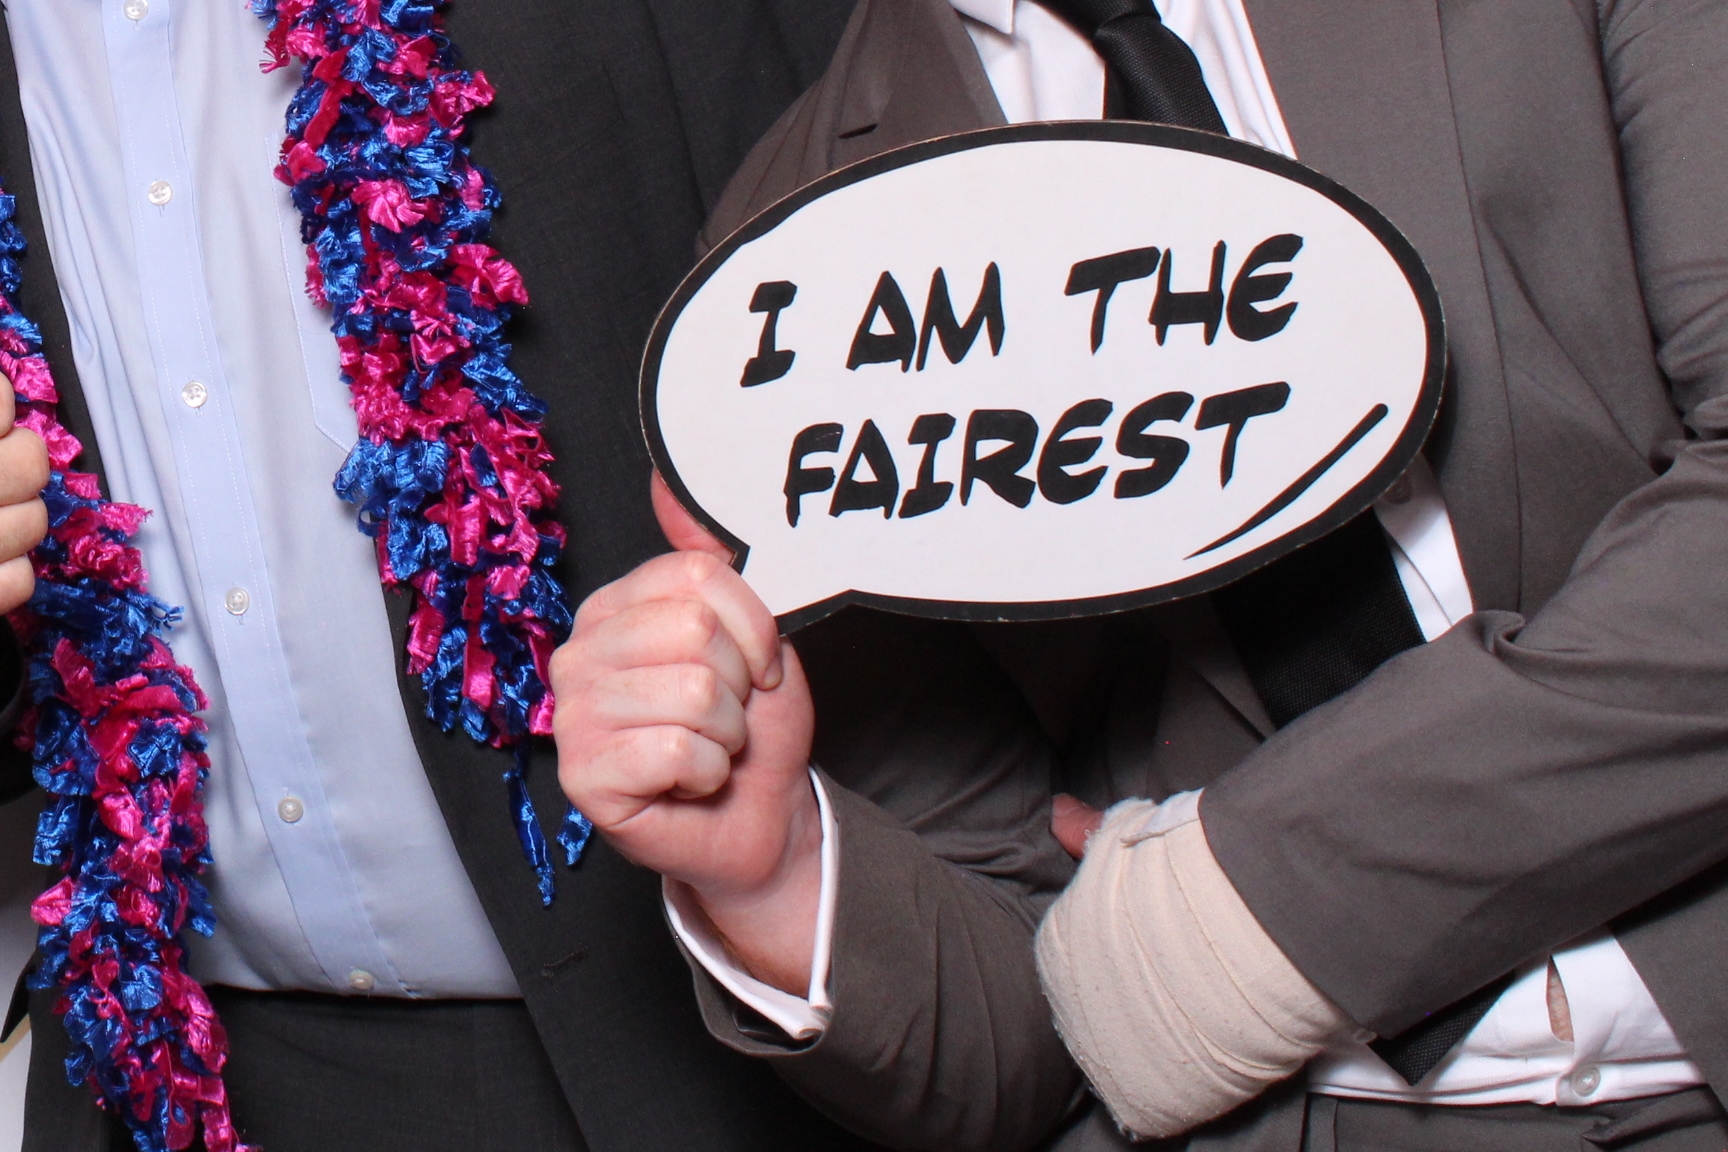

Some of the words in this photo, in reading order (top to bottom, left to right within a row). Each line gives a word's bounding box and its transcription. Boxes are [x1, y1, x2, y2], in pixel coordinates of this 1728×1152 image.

[740, 281, 797, 387] I
[846, 261, 1005, 372] AM
[1065, 233, 1304, 355] THE
[783, 381, 1291, 528] FAIREST
